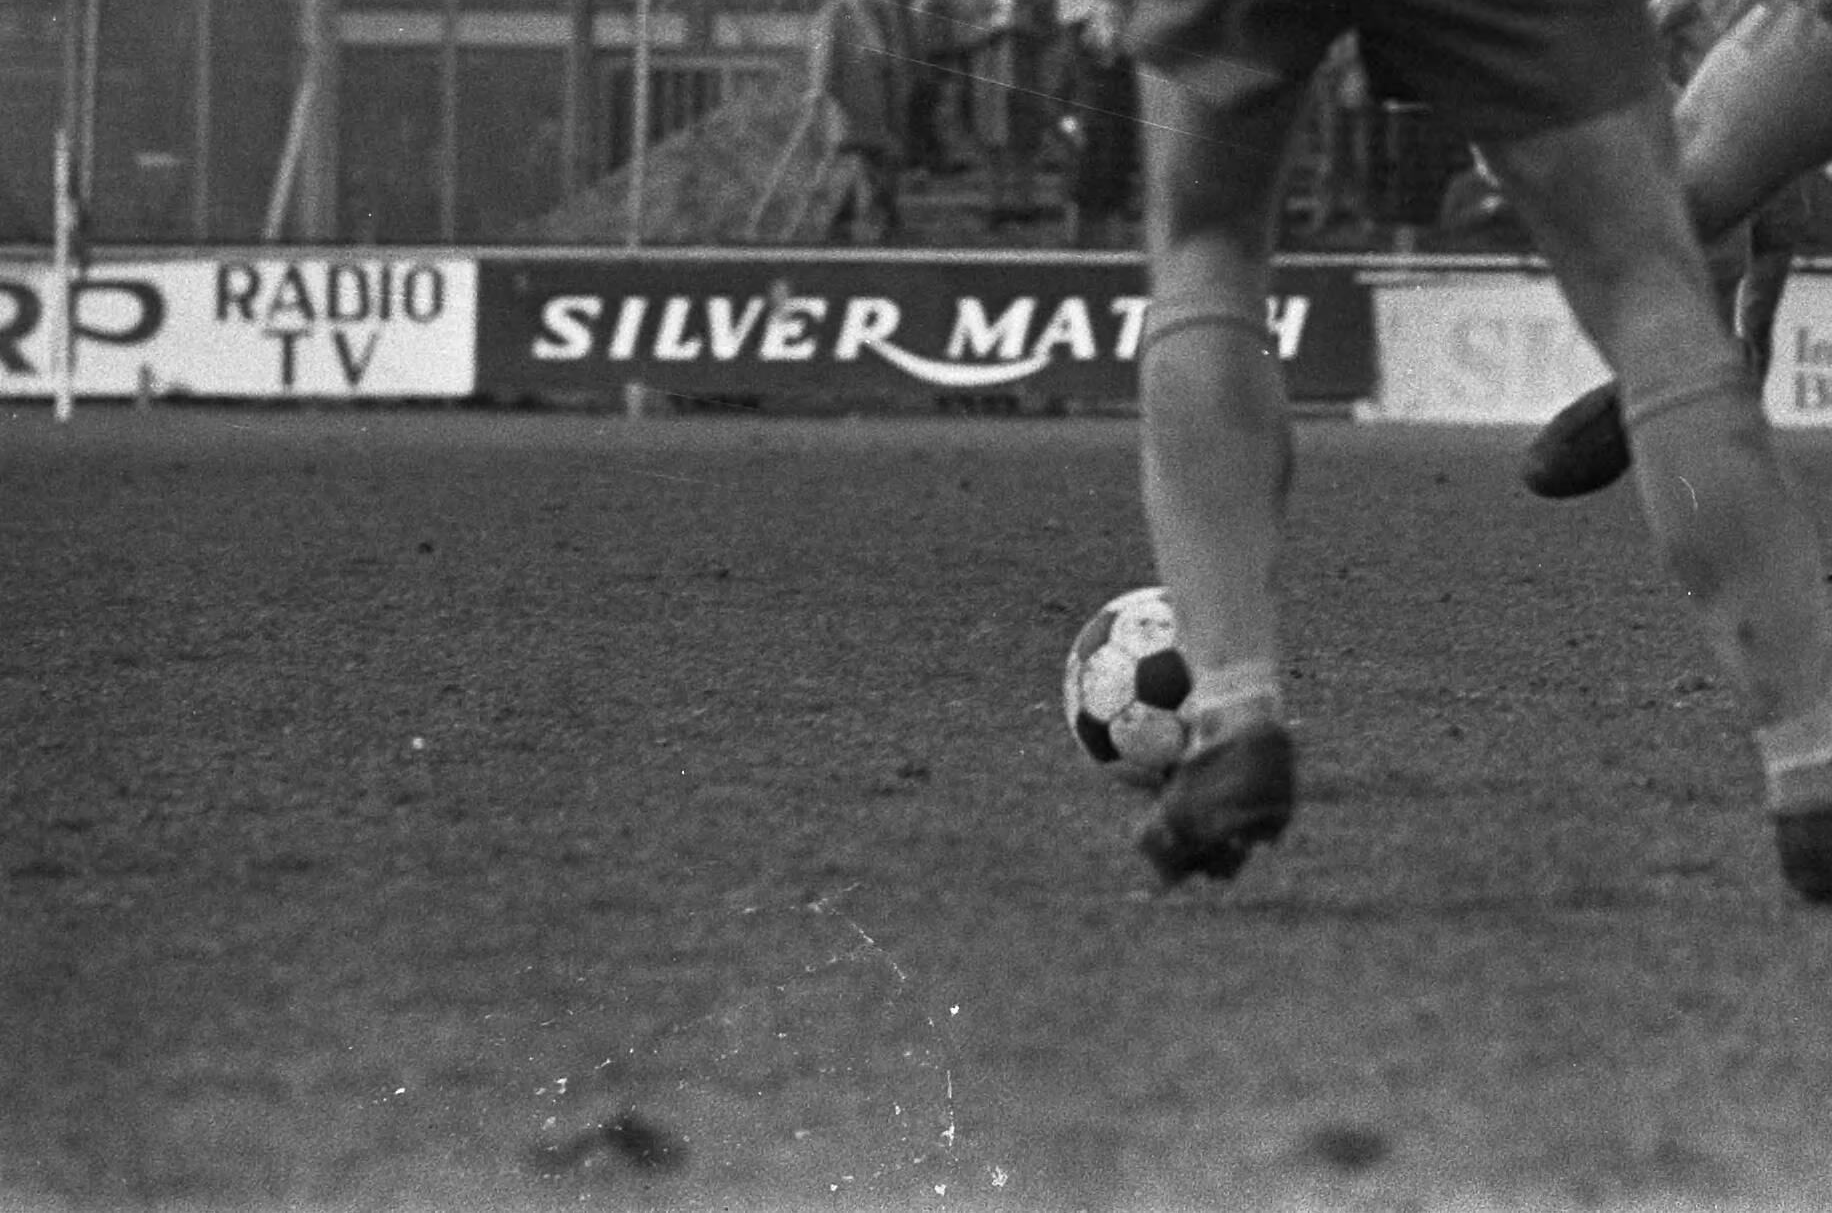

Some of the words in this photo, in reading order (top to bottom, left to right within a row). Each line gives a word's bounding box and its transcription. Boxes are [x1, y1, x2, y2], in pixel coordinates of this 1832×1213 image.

[216, 264, 444, 323] RADIO
[262, 328, 379, 387] TV
[532, 295, 902, 361] SILVER
[947, 295, 1309, 361] MATH
